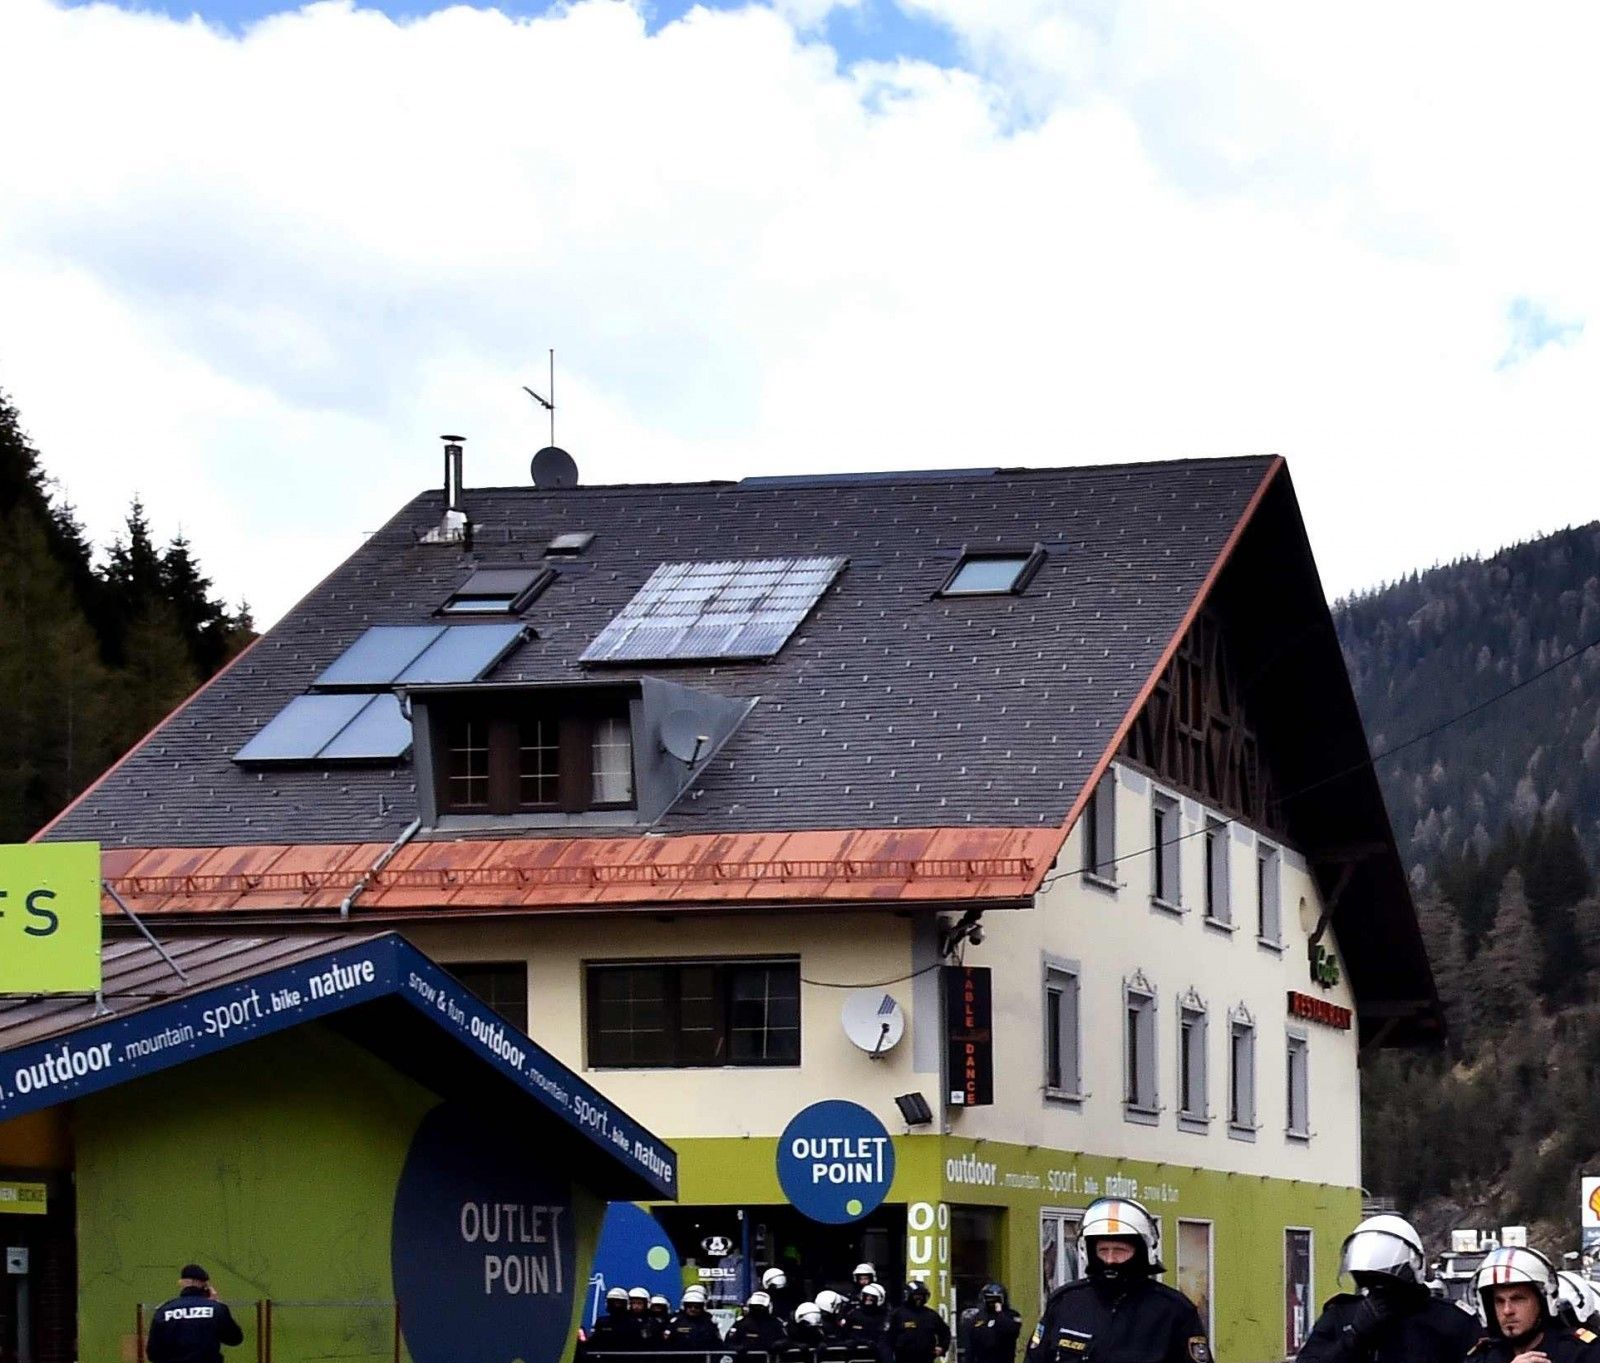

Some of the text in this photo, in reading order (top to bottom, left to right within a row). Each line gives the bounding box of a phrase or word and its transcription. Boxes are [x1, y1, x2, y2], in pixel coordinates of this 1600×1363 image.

[0, 889, 59, 937] S
[15, 1041, 113, 1094] outdoor
[125, 1023, 194, 1060] mountain
[203, 988, 264, 1038] sport
[271, 989, 300, 1013] bike
[308, 958, 375, 1001] nature
[408, 972, 436, 1002] snow
[447, 998, 465, 1026] fun
[471, 1016, 526, 1070] outdoor
[574, 1095, 608, 1136] sport
[634, 1141, 672, 1182] nature
[965, 1043, 976, 1105] DANCE
[792, 1137, 887, 1160] OUTLET
[812, 1162, 884, 1184] POINT
[946, 1153, 997, 1186] outdoor
[1048, 1166, 1077, 1198] sport
[1105, 1171, 1139, 1199] nature
[461, 1201, 563, 1243] OUTLET
[485, 1254, 562, 1295] POINT
[164, 1306, 214, 1322] POLIZEI
